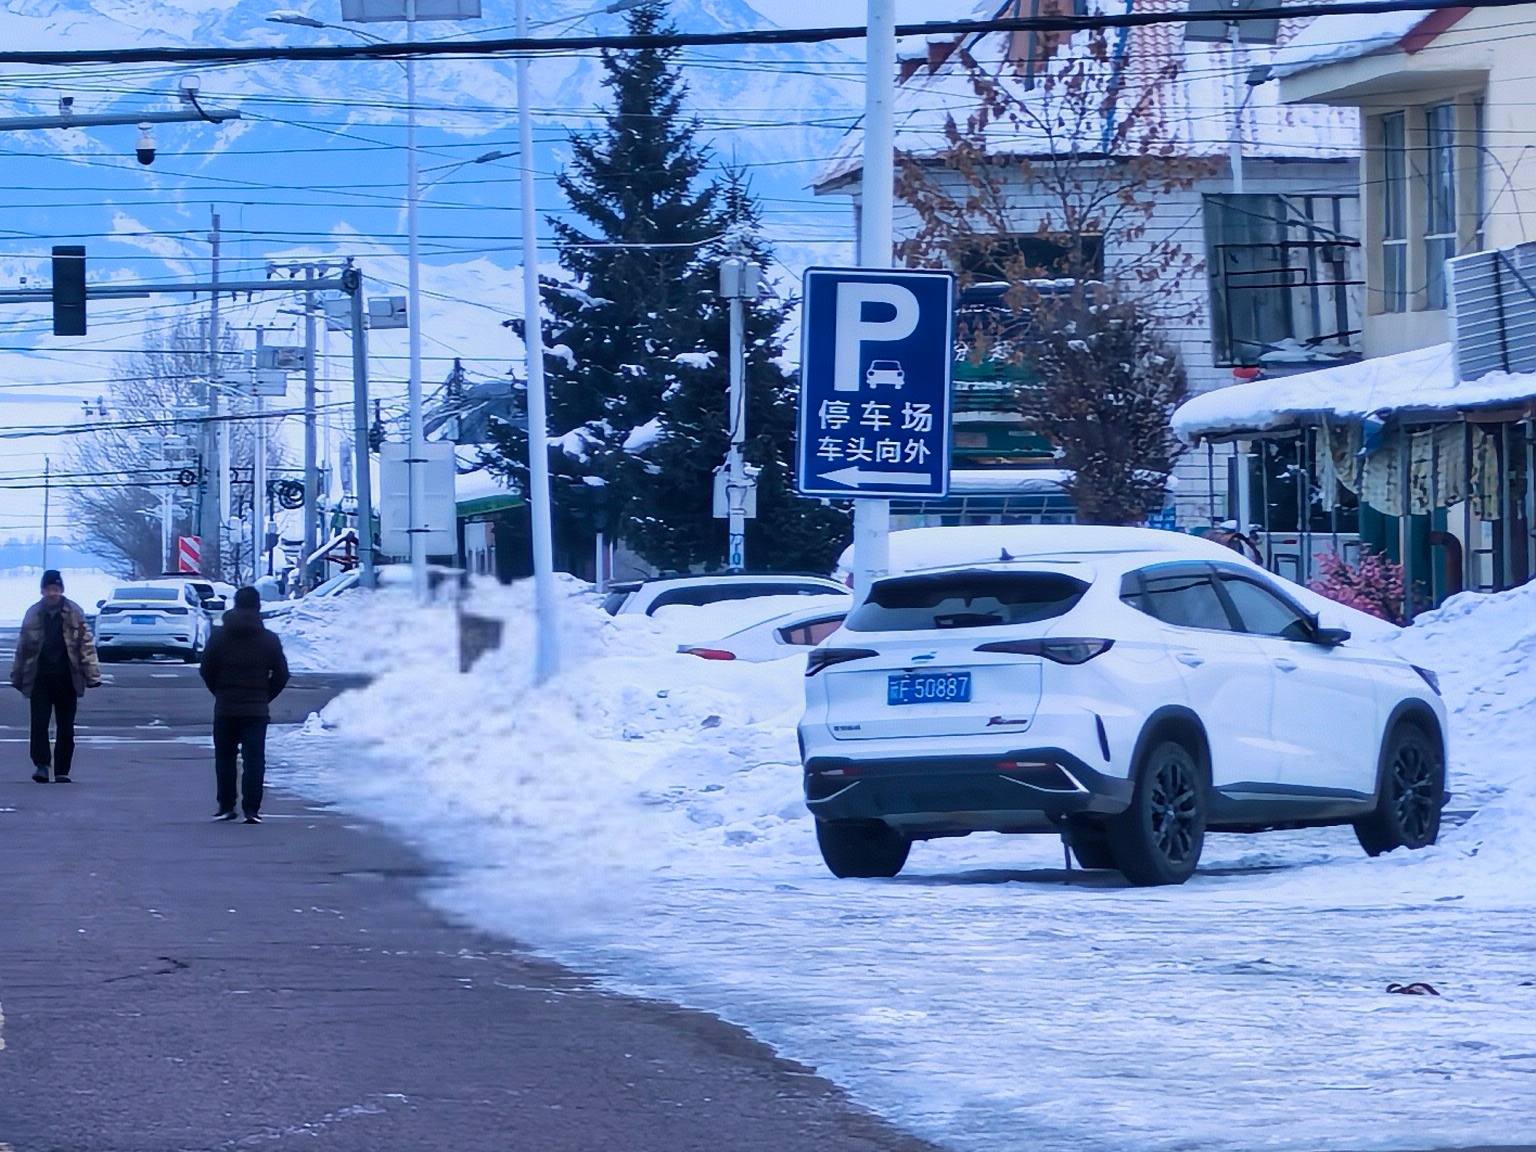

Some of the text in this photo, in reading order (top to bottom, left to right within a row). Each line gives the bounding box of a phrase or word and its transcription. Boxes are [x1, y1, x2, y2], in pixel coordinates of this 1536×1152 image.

[834, 282, 920, 392] P
[818, 399, 934, 432] 停车场
[816, 437, 932, 465] 车头向外
